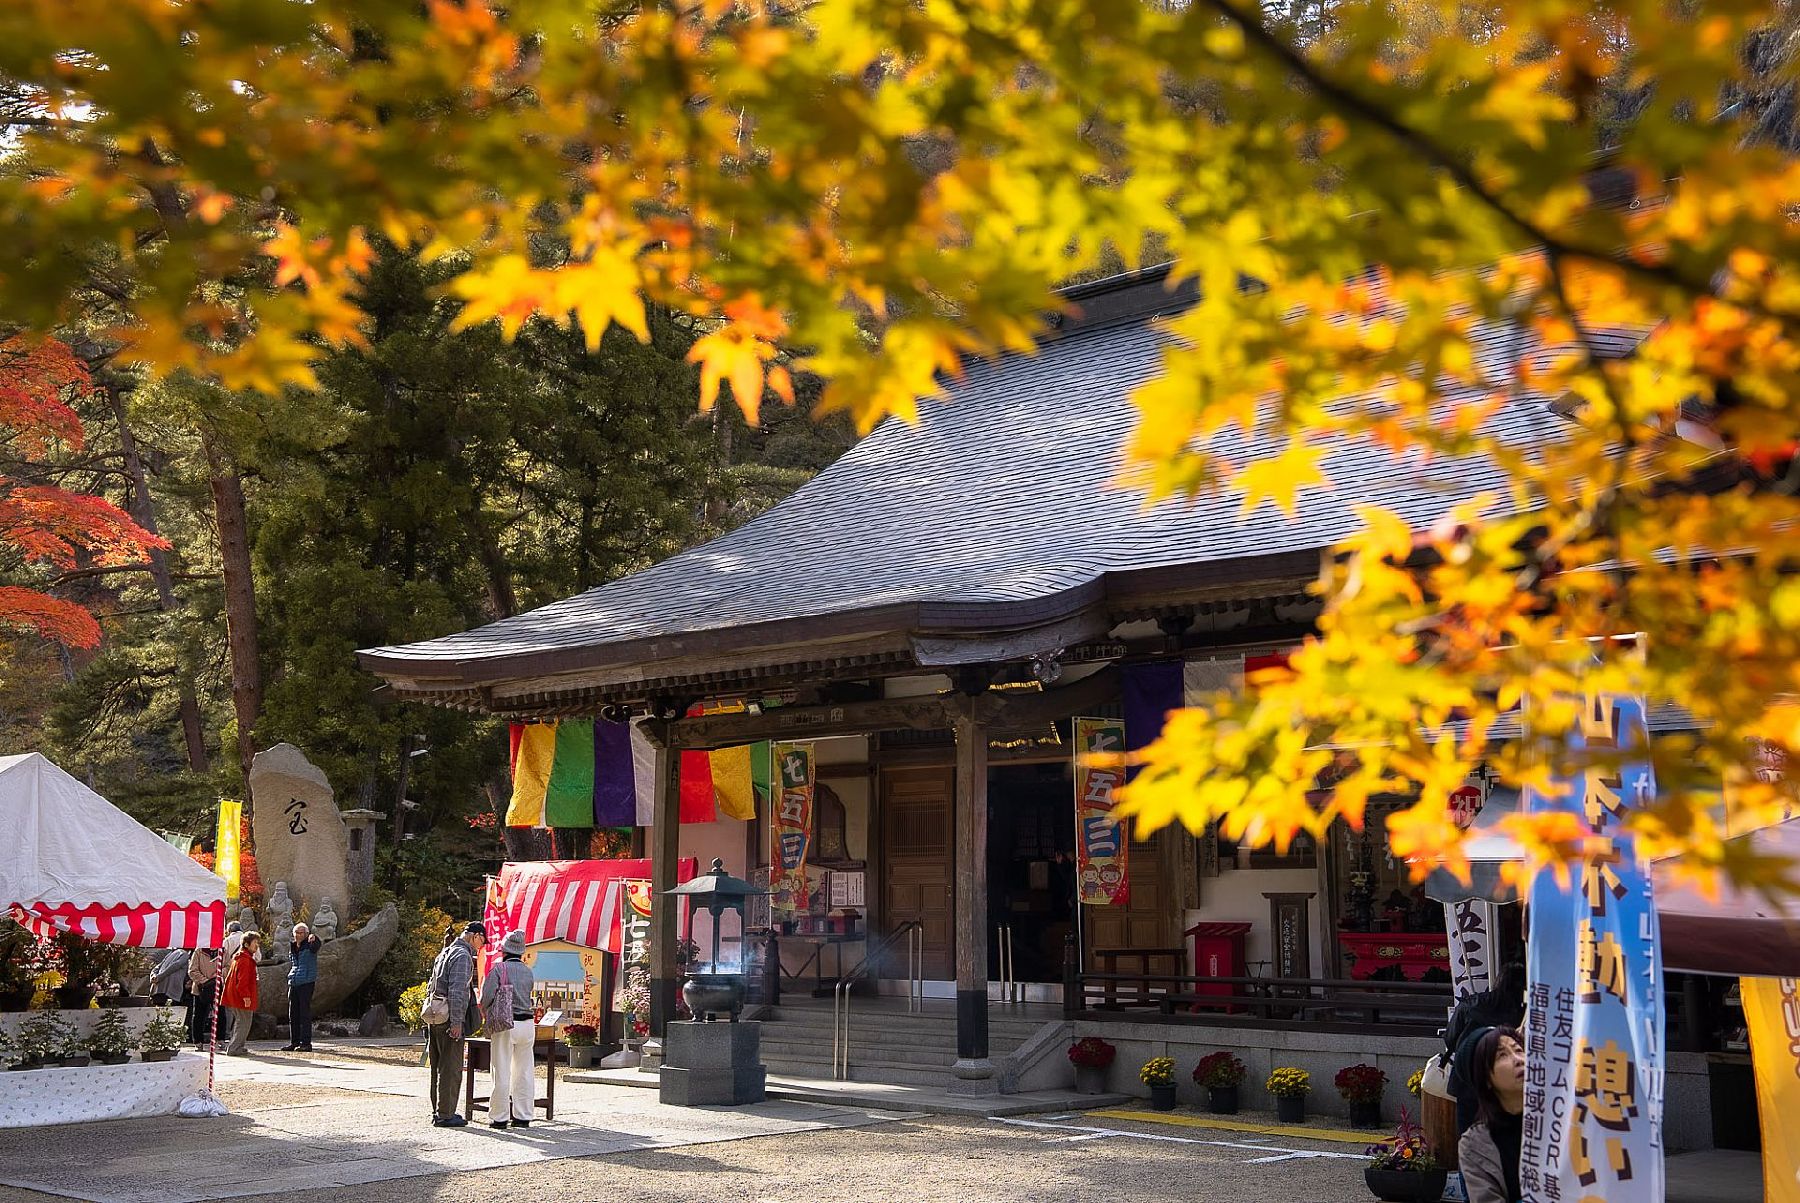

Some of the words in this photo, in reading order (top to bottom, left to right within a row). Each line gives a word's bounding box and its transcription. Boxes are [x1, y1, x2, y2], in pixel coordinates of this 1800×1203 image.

[779, 754, 806, 865] 七五三
[1452, 792, 1482, 829] 祝
[1543, 986, 1575, 1203] 住友ゴムCSR基
